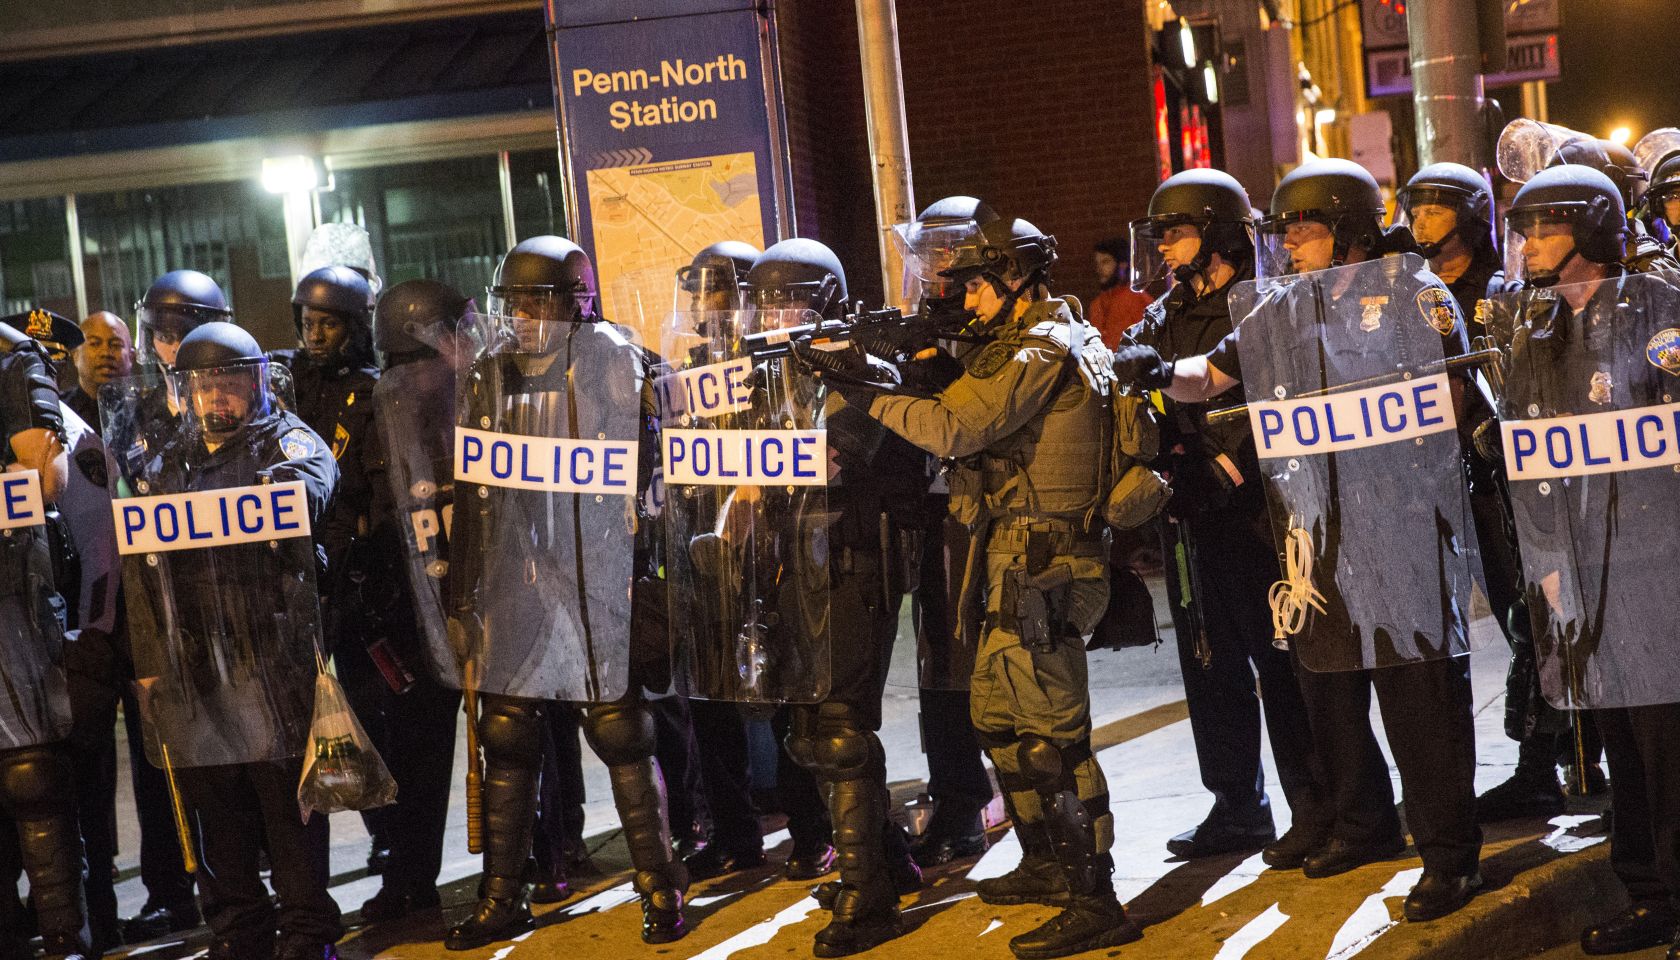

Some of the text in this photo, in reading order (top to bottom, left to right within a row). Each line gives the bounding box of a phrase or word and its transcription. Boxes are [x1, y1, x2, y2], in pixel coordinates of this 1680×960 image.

[572, 54, 747, 96] Penn-North
[609, 96, 717, 131] Station
[1258, 383, 1445, 449] POLICE
[462, 436, 628, 487] POLICE
[669, 437, 817, 477] POLICE
[123, 489, 300, 546] POLICE
